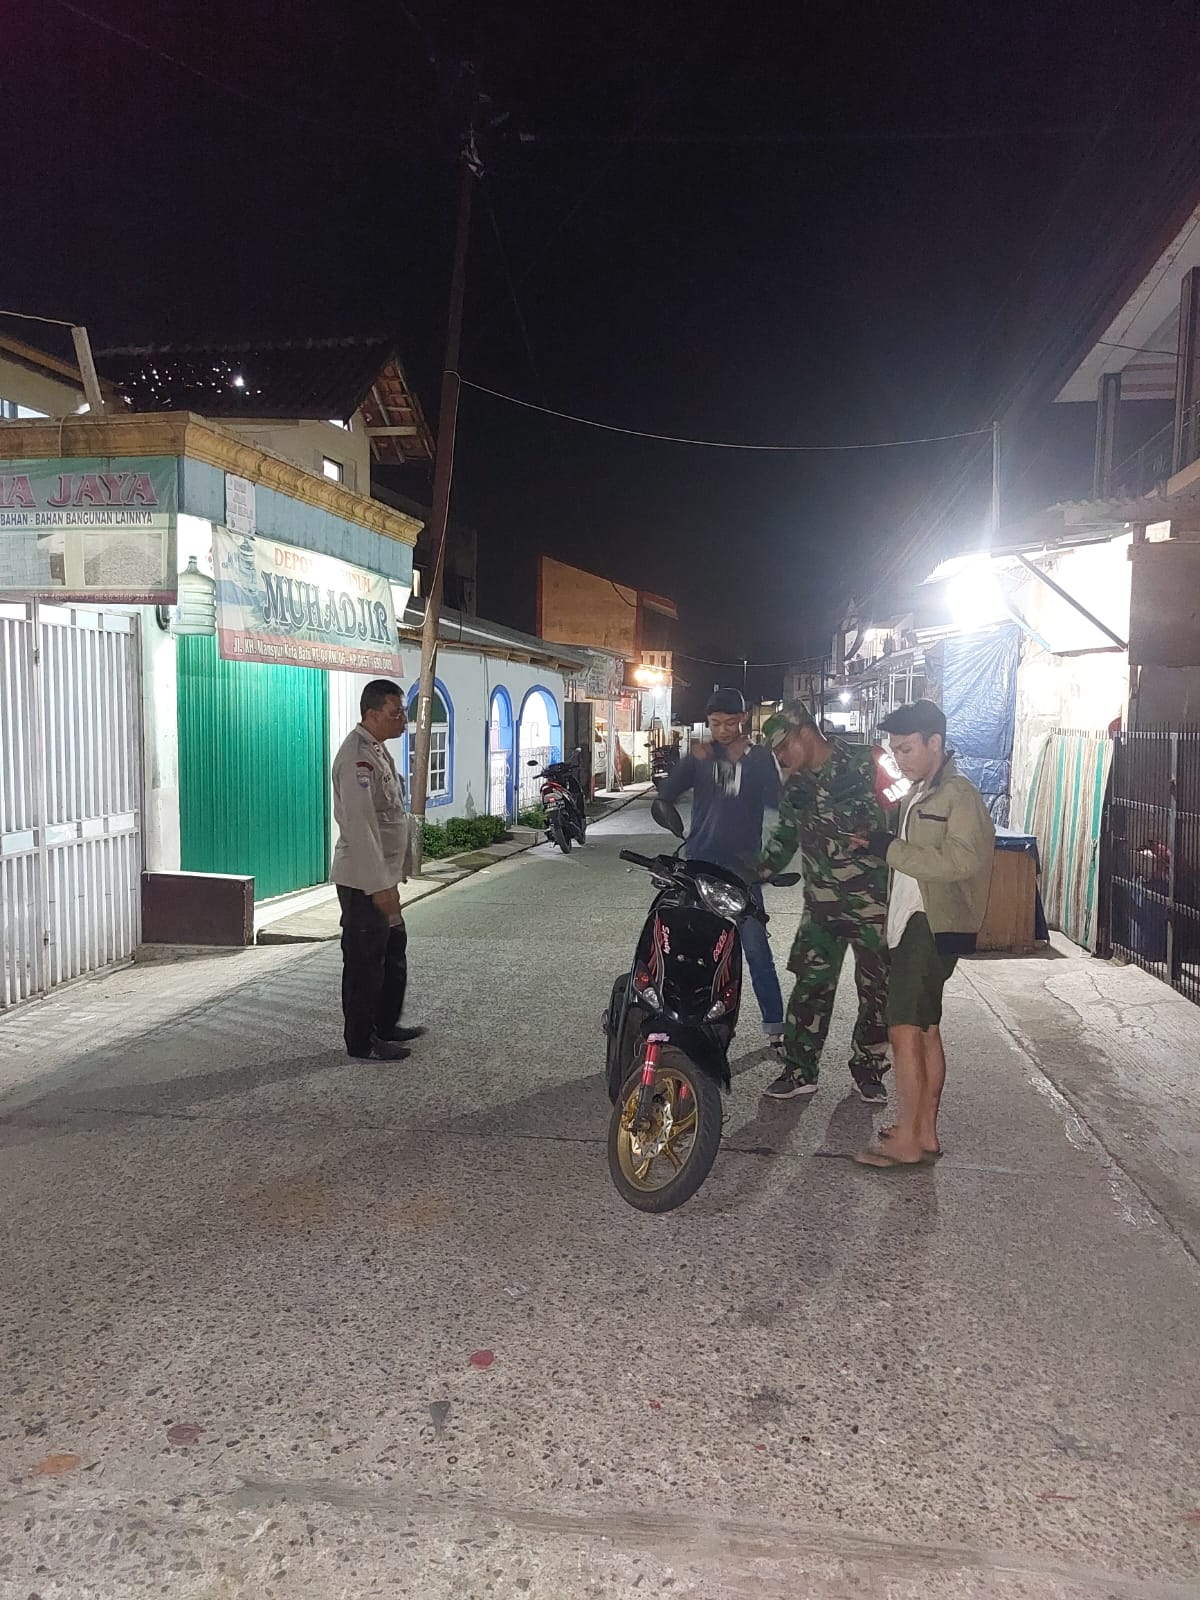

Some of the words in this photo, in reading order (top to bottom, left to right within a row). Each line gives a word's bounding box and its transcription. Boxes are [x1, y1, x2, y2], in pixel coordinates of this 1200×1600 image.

[47, 473, 158, 507] JAYA
[1, 513, 28, 526] BAHAN
[35, 512, 64, 526] BAHAN
[66, 511, 113, 525] BANGUNAN
[115, 511, 153, 525] LAINNYA
[261, 571, 392, 645] MUHADJIR
[233, 637, 243, 653] Jl.
